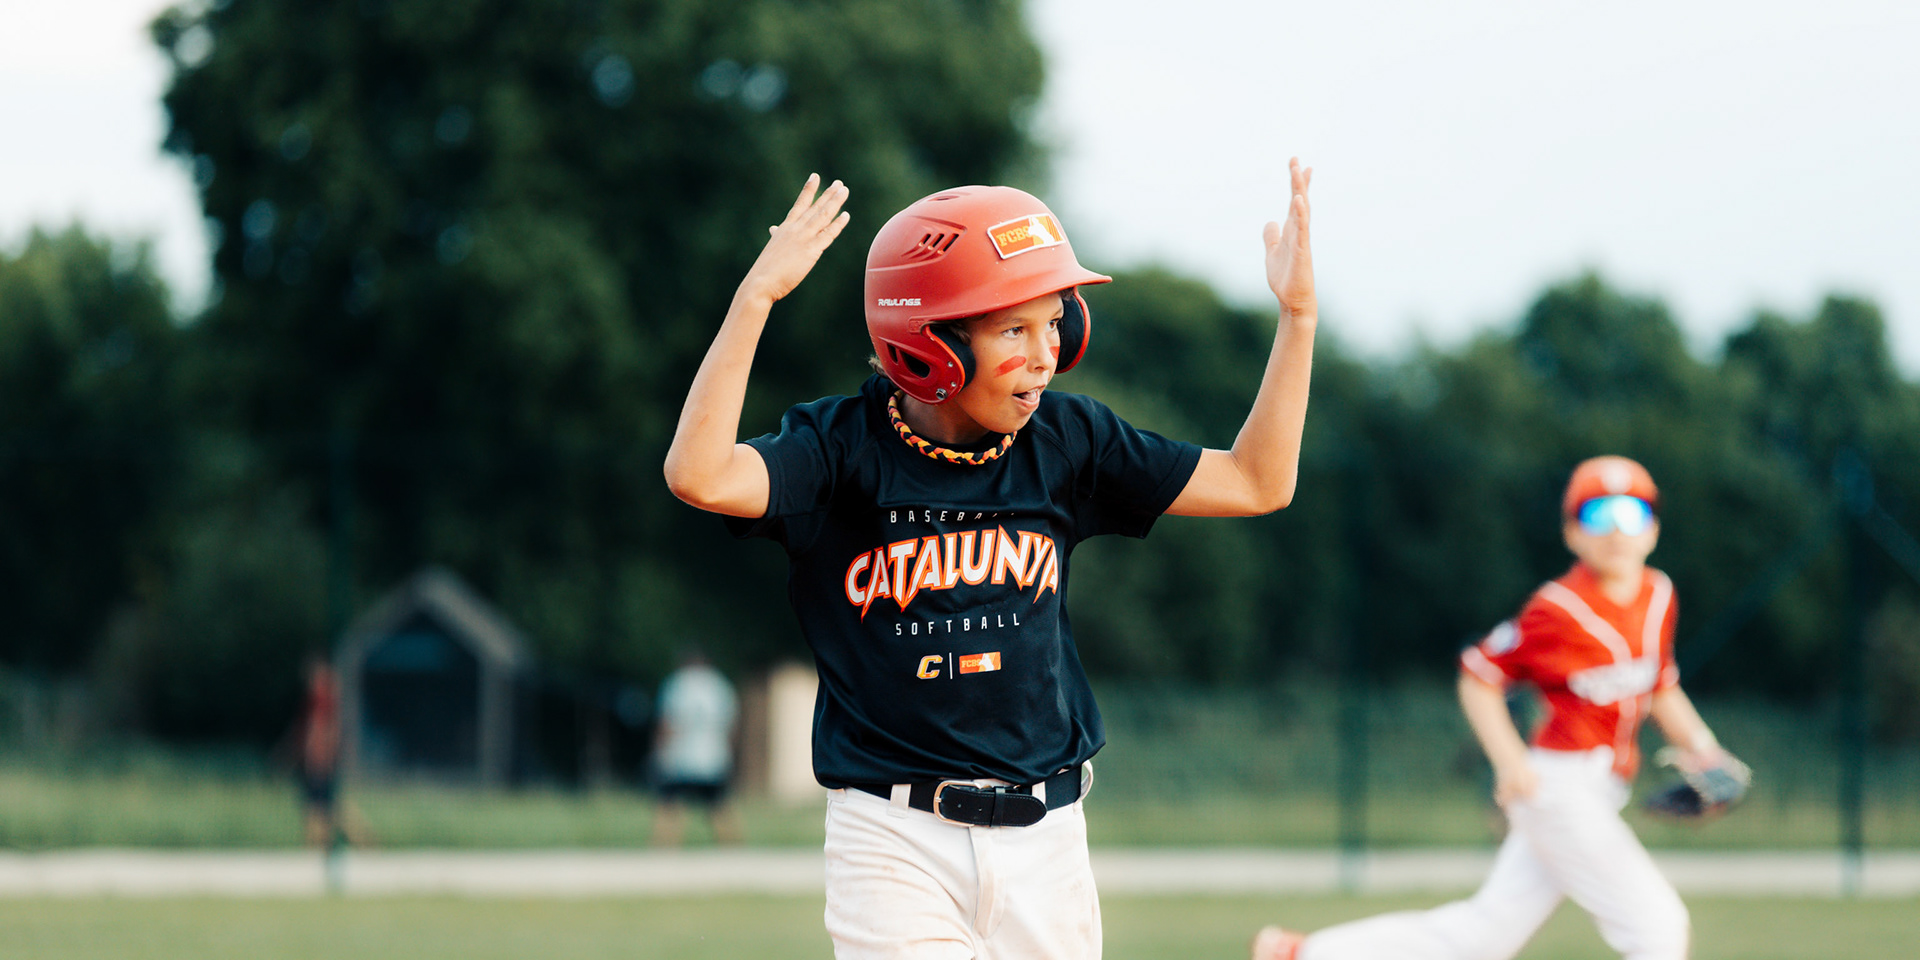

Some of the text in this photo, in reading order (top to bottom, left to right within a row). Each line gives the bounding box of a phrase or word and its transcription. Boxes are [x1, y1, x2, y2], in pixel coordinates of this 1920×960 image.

[878, 298, 921, 306] RAWLINGS
[890, 510, 1015, 523] BASEBA
[844, 524, 1059, 624] CATALUNYA
[896, 613, 1020, 636] SOFTBALL
[916, 654, 943, 679] C
